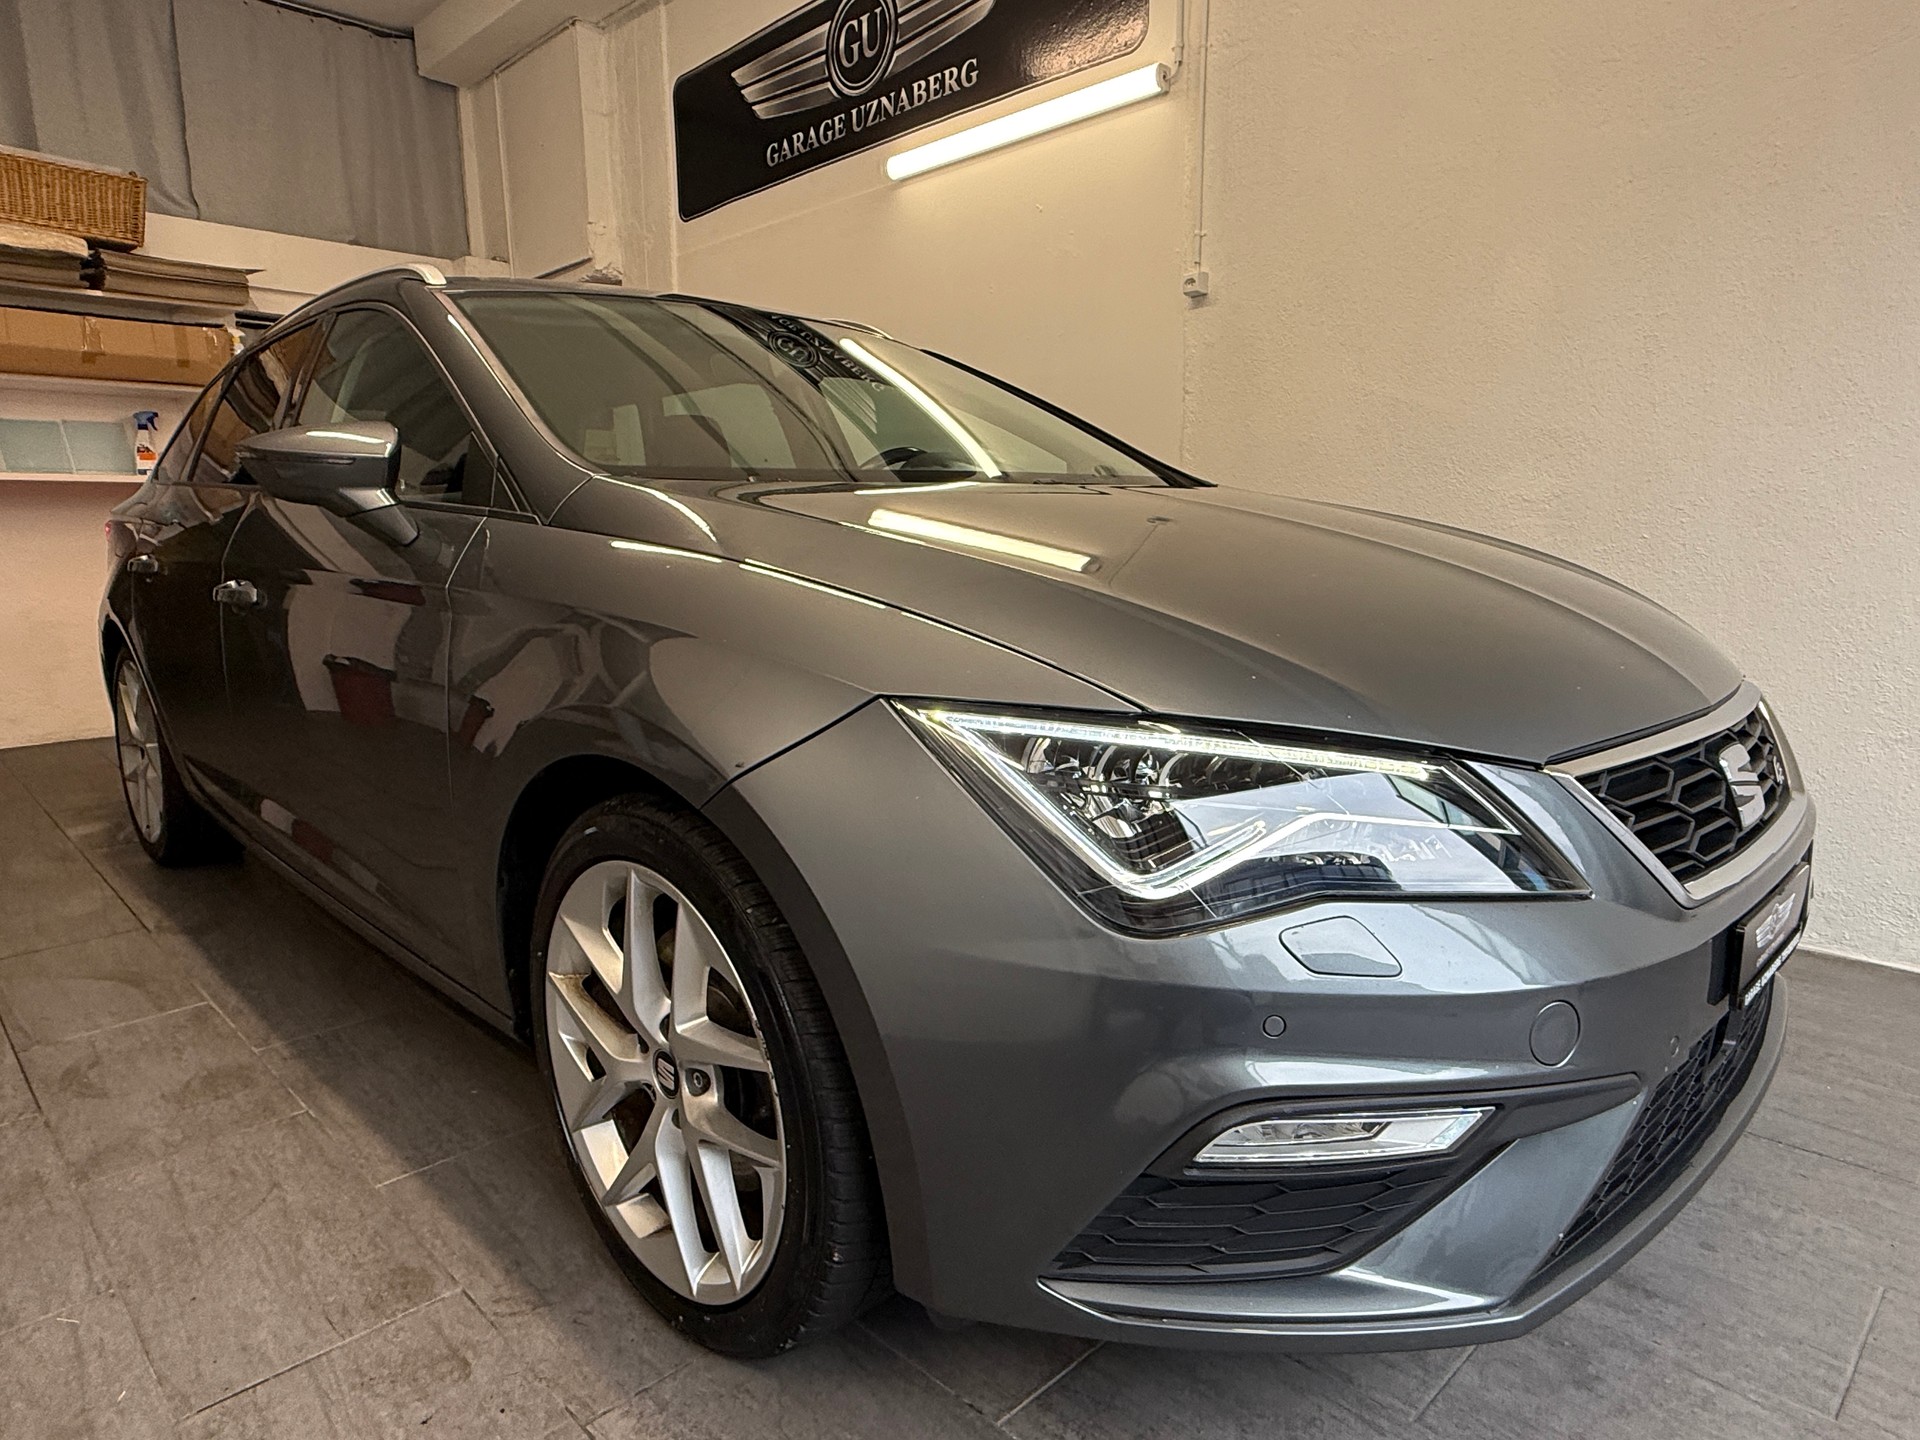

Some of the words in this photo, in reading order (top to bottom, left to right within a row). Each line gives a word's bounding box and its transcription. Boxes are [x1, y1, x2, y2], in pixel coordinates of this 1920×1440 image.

[839, 7, 882, 68] GU
[766, 113, 847, 168] GARAGE
[851, 58, 979, 133] UZNABERG
